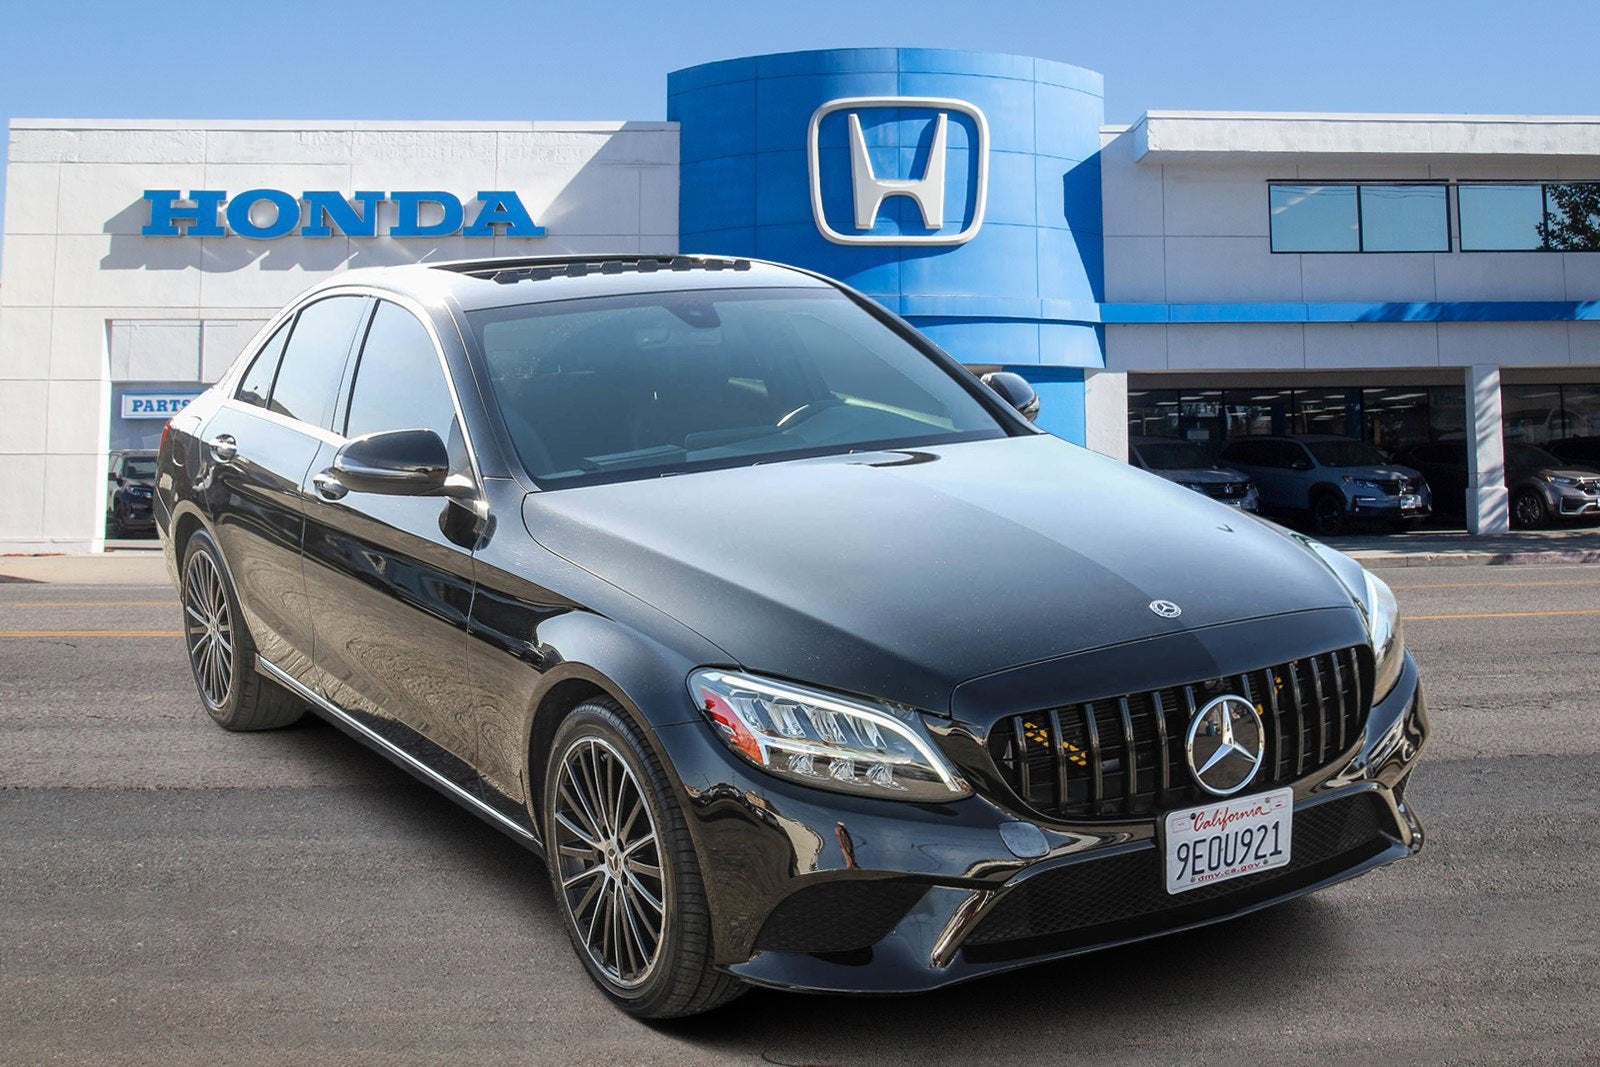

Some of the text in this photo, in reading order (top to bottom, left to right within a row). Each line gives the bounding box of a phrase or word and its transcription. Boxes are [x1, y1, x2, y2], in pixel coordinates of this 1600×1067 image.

[141, 189, 547, 239] HONDA
[1193, 803, 1271, 832] California
[1198, 861, 1261, 882] dmv.ca.gov
